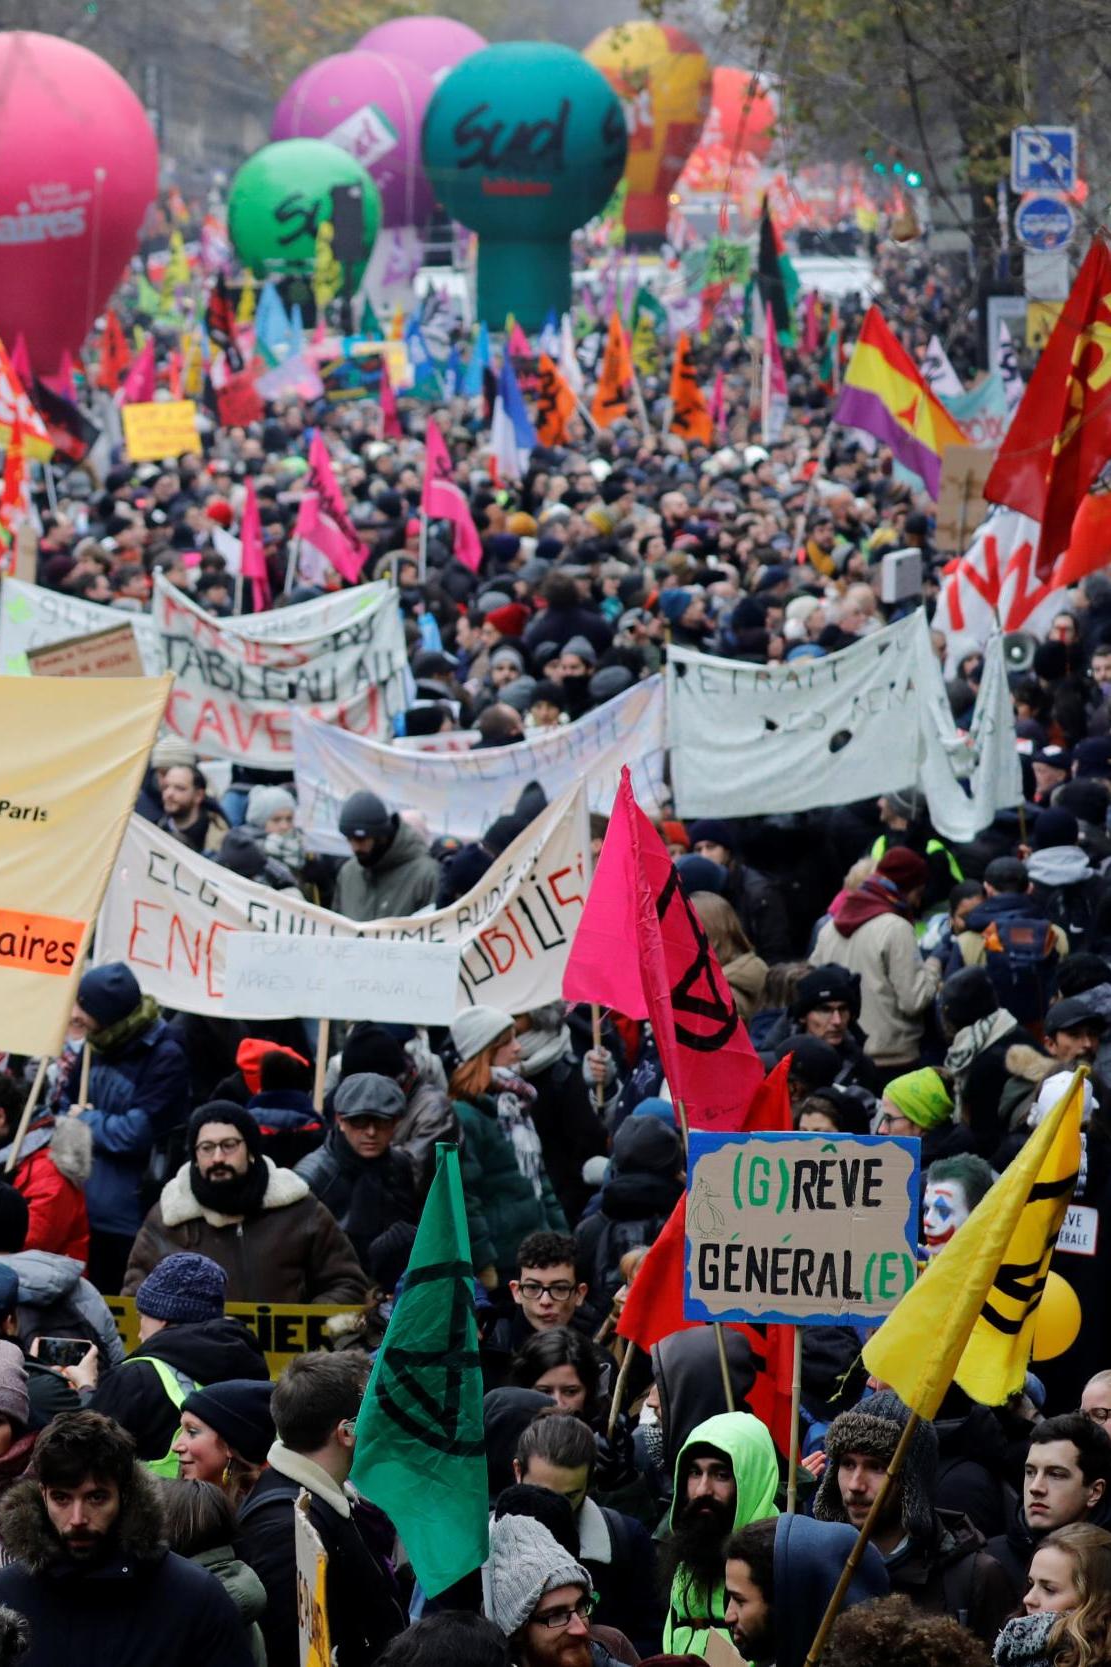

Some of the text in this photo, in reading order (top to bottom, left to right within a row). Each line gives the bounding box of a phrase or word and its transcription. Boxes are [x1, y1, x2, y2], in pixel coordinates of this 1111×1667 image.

[454, 98, 571, 172] Sud
[1019, 134, 1051, 177] P
[732, 1143, 883, 1214] (G)RÊVE
[698, 1232, 915, 1304] GÉNÉRAL(E)
